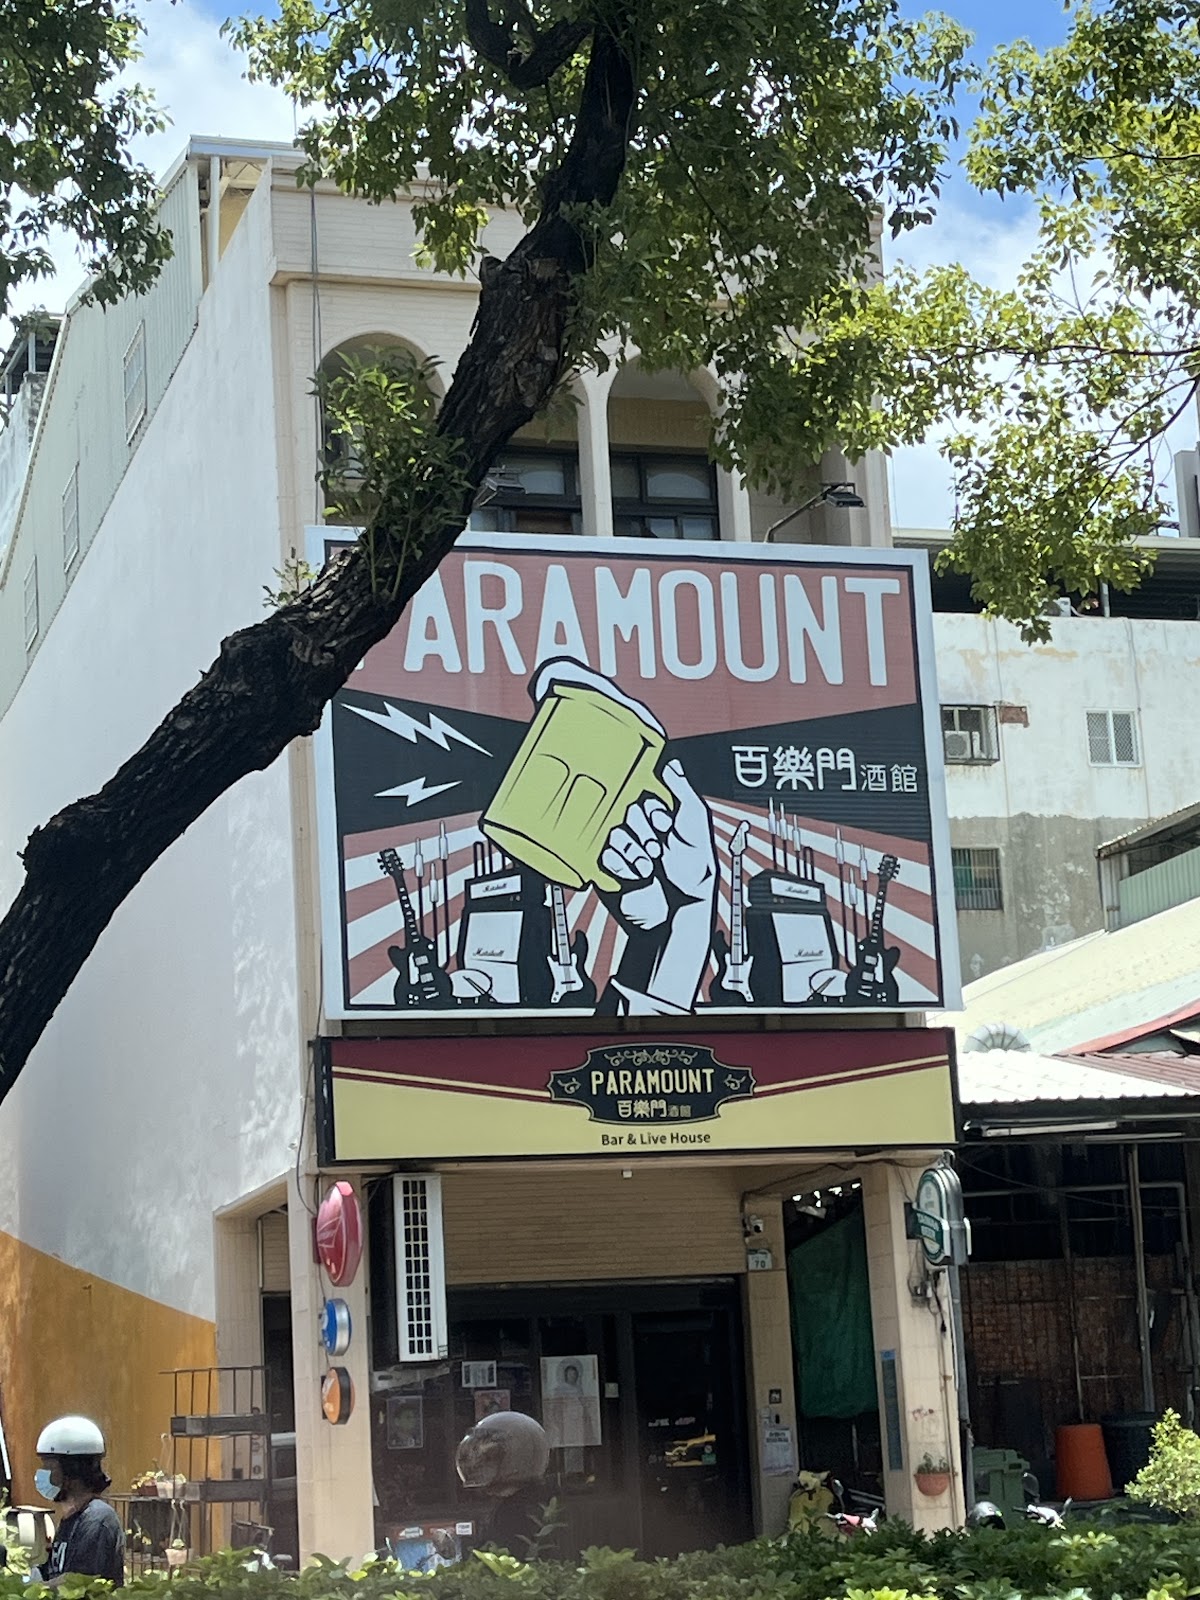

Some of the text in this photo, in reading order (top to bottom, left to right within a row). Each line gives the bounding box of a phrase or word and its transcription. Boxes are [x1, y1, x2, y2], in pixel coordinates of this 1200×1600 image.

[355, 560, 901, 687] ARAMOUNT
[731, 745, 918, 793] 百樂門酒館
[591, 1069, 714, 1095] PARAMOUNT
[601, 1131, 711, 1146] Bar & Live House
[754, 1260, 766, 1269] 70
